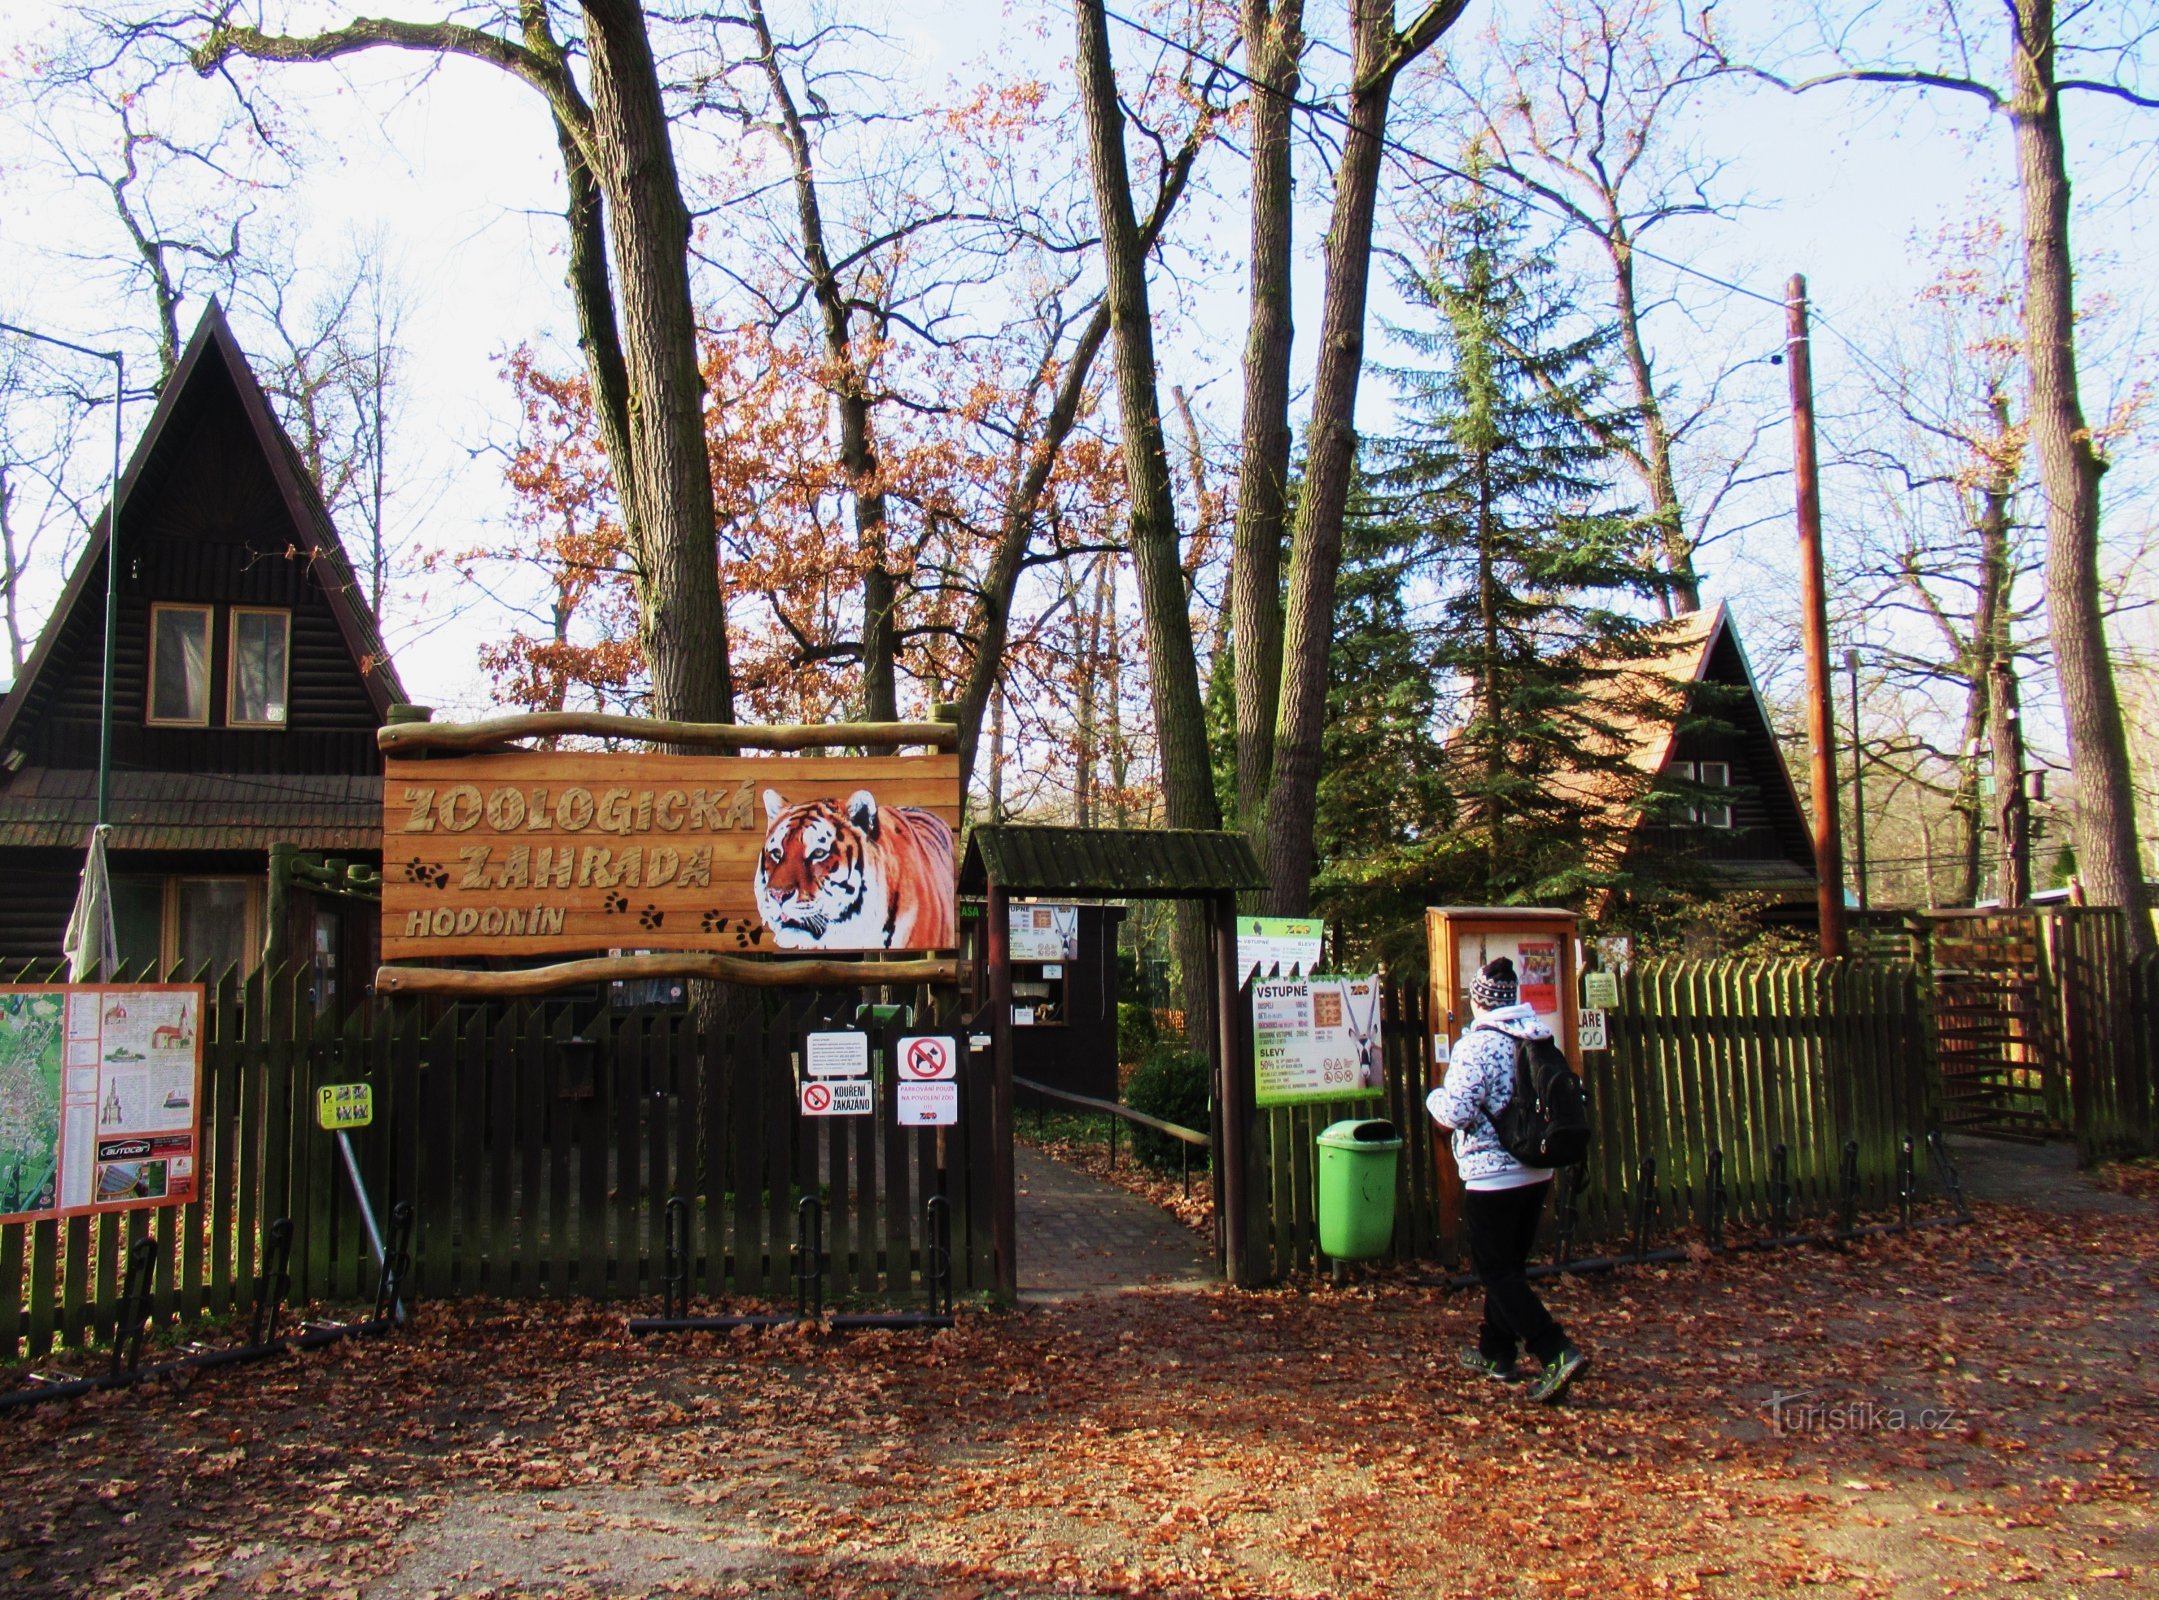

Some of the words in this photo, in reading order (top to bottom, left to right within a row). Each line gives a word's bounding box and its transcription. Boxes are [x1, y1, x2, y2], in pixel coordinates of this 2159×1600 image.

[404, 777, 756, 836] ZOOLOGICKÁ
[459, 845, 714, 889] ZAHRADA
[960, 906, 979, 917] ASA
[405, 902, 566, 937] HODONÍN
[1257, 981, 1308, 998] VSTUPNÉ
[1579, 1031, 1603, 1046] OO
[1260, 1048, 1285, 1057] SLEVY
[323, 1090, 332, 1104] P
[834, 1084, 866, 1097] KOUŘENÍ
[832, 1097, 870, 1111] ZAKÁZÁNO
